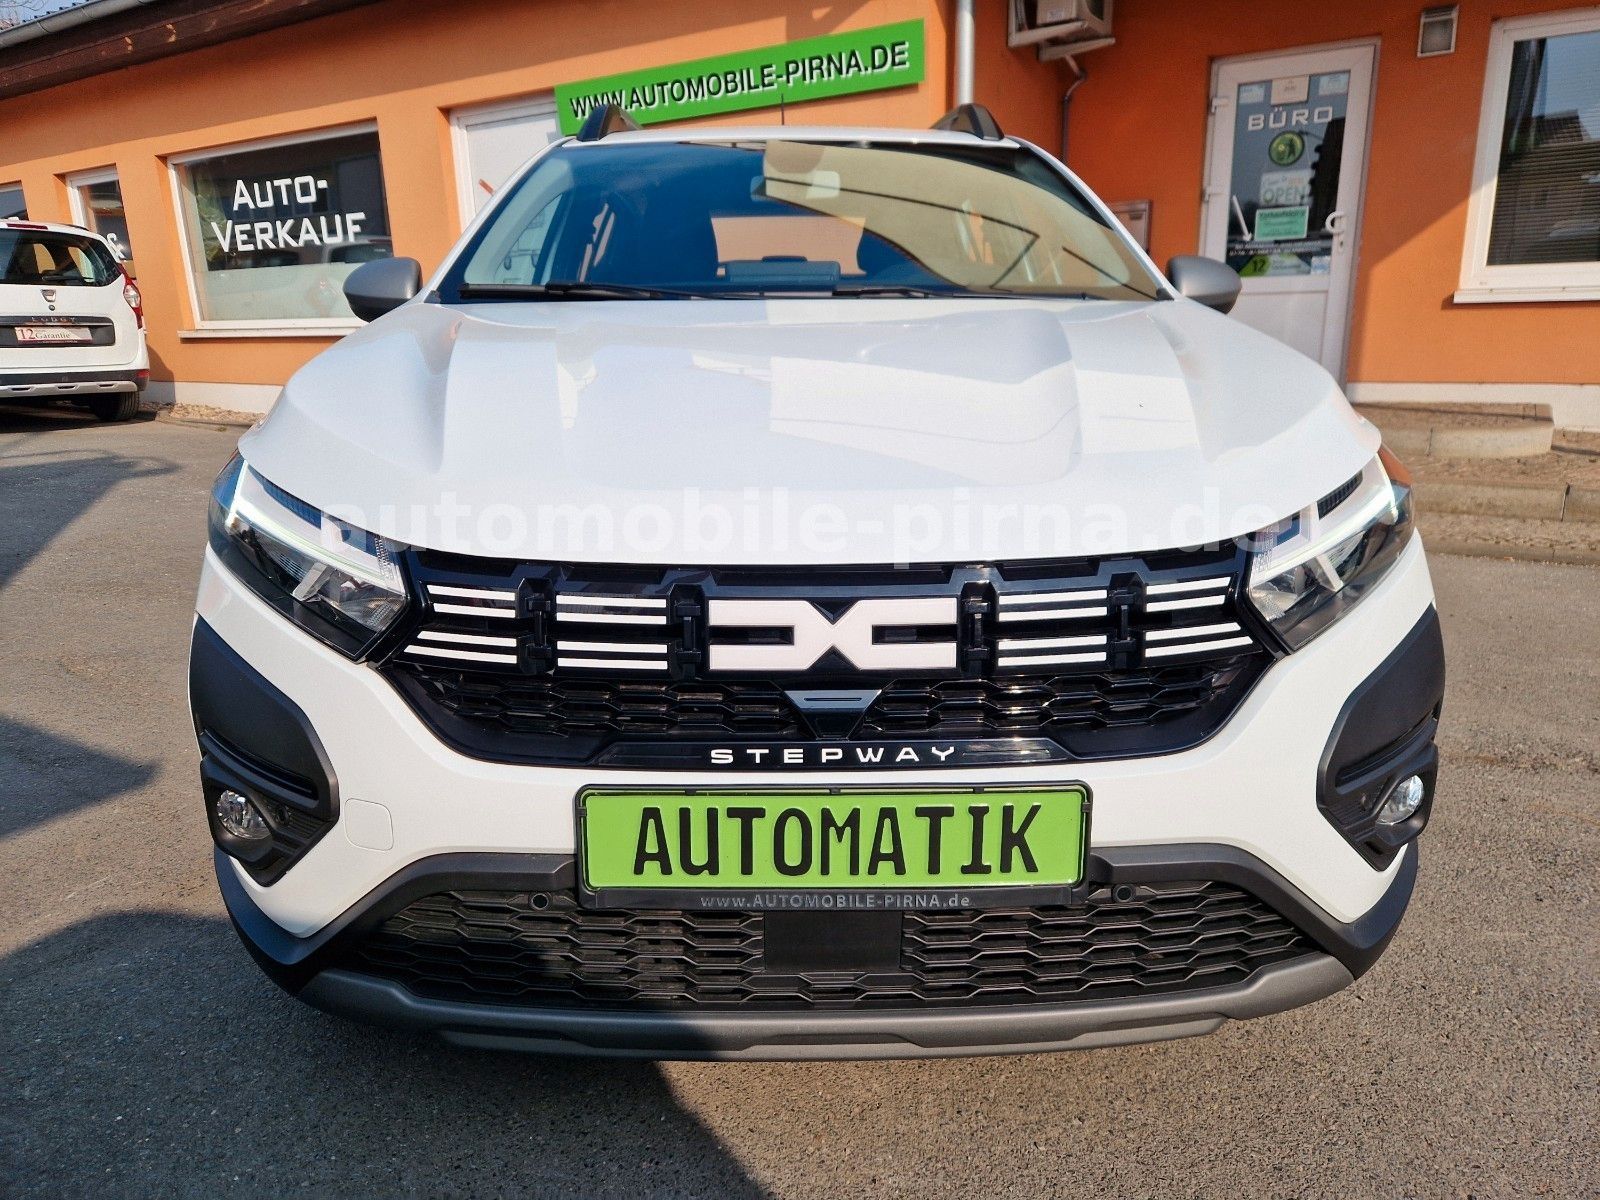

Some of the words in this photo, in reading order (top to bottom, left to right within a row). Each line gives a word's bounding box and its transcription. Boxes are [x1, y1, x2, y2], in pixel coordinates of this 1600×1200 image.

[569, 39, 910, 120] WWW.AUTOMOBILE-PIRNA.DE
[1247, 106, 1333, 131] BÜRO
[233, 175, 328, 211] AUTO-
[210, 211, 367, 252] VERKAUF
[18, 328, 35, 340] 12
[709, 746, 956, 765] STEPWAY
[633, 804, 1041, 876] AUTOMATIK
[700, 894, 970, 909] www.AUTOMOBILE-PIRNA.de
